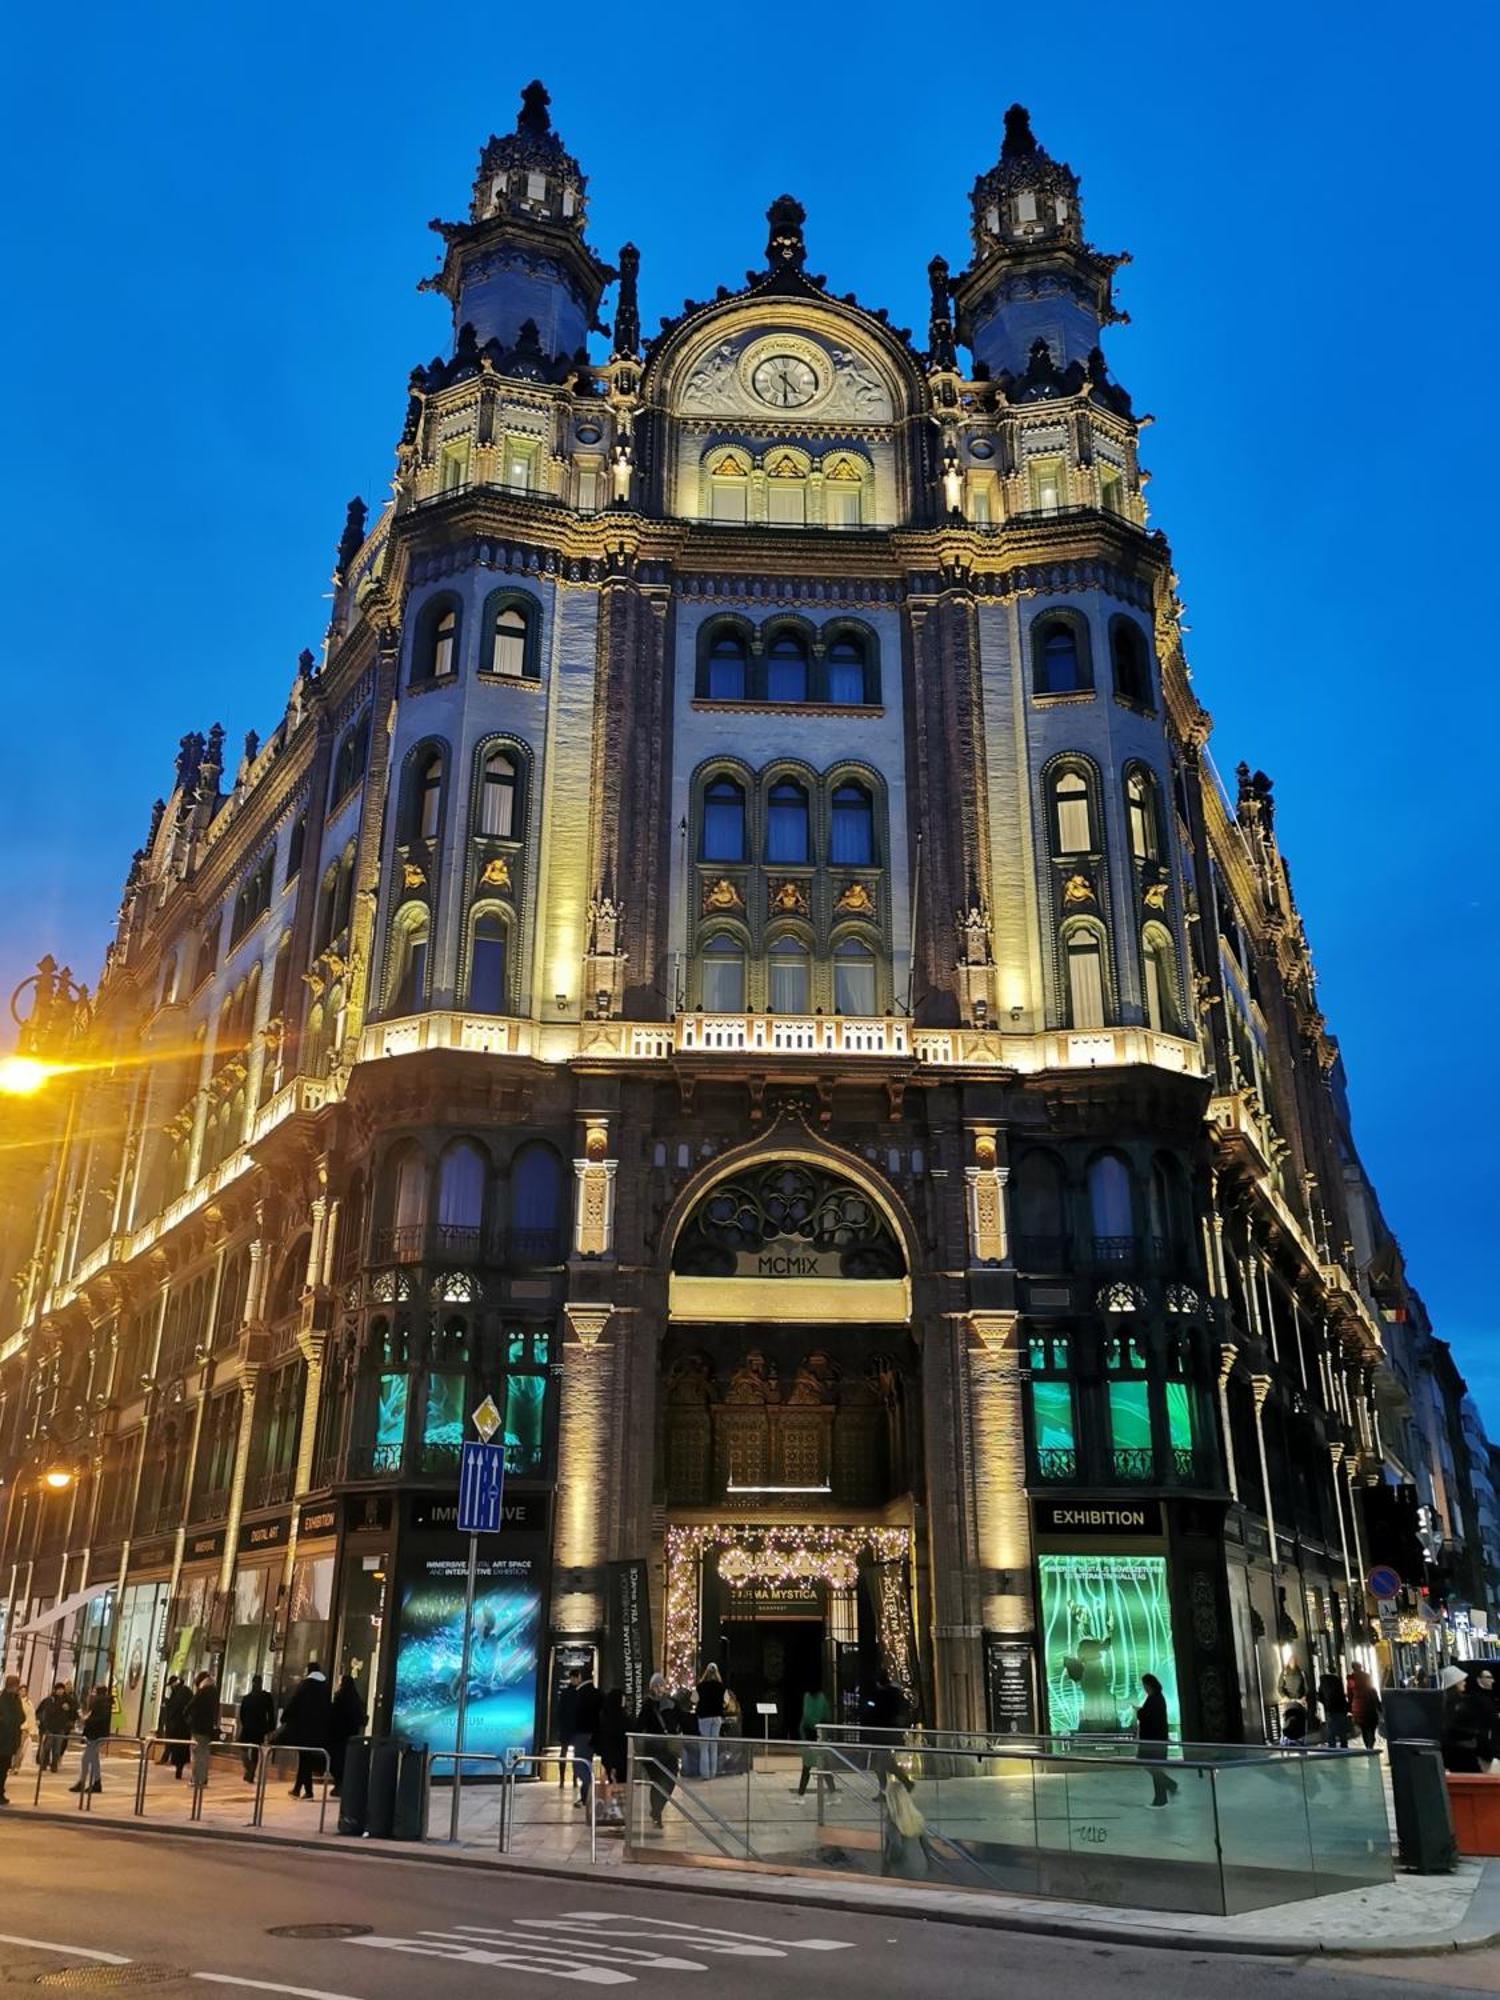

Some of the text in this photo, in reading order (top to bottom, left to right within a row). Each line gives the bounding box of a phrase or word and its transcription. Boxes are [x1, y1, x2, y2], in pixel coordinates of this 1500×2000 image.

[758, 1256, 819, 1274] MCMIX
[431, 1507, 527, 1521] IMMIVE
[1053, 1510, 1145, 1525] EXHIBITION
[426, 1561, 467, 1569] IMMERSIVE
[492, 1561, 507, 1569] ART
[508, 1561, 532, 1569] SPACE
[444, 1568, 492, 1576] INTERATIVE
[771, 1589, 818, 1600] MYSTICA
[340, 1911, 858, 1985] BUSZ
